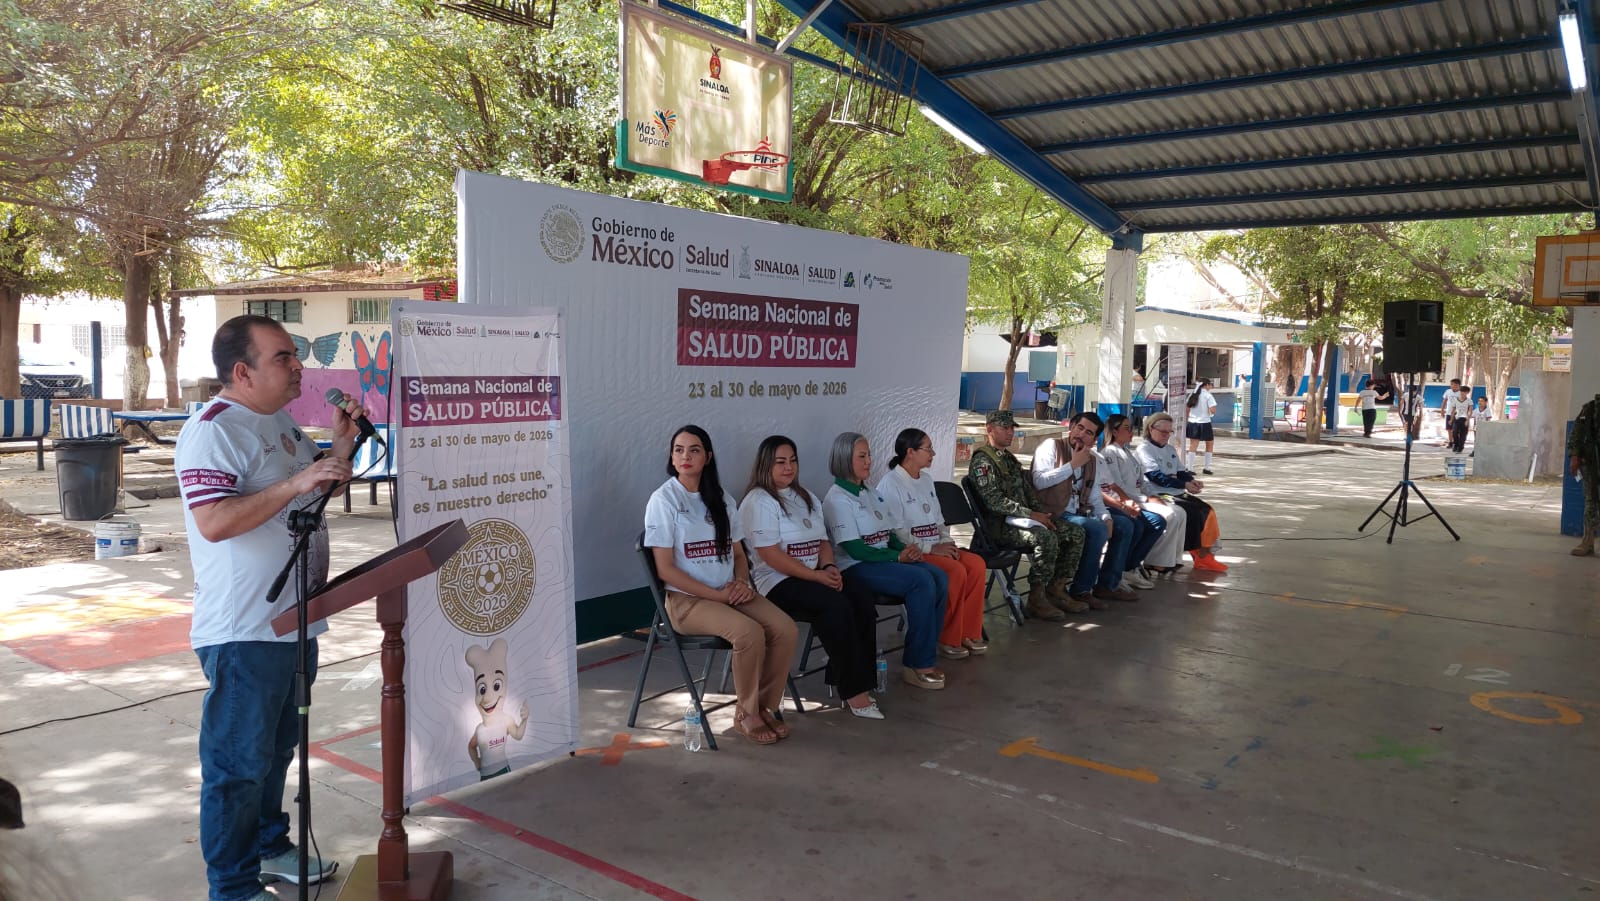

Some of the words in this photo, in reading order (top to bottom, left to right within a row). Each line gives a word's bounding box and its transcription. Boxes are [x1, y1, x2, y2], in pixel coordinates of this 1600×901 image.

[700, 78, 730, 95] SINALOA
[636, 121, 656, 136] Más
[639, 133, 670, 149] Deporte
[592, 216, 657, 241] Gobierno
[660, 227, 675, 243] de
[591, 233, 675, 270] México
[686, 244, 729, 269] Salud
[754, 259, 800, 276] SINALOA
[808, 266, 836, 280] SALUD
[688, 295, 759, 322] Semana
[765, 301, 831, 327] Nacional
[834, 307, 852, 327] de
[417, 326, 452, 337] México
[456, 326, 476, 335] Salud
[688, 331, 763, 359] SALUD
[769, 329, 850, 361] PÚBLICA
[408, 380, 470, 395] Semana
[475, 379, 533, 394] Nacional
[537, 378, 553, 393] de
[688, 383, 706, 398] 23
[711, 381, 723, 396] al
[728, 382, 744, 396] 30
[749, 381, 765, 395] de
[768, 383, 802, 399] mayo
[805, 381, 818, 395] de
[823, 381, 847, 395] 2026
[408, 402, 474, 422] SALUD
[480, 397, 553, 419] PÚBLICA
[409, 437, 425, 449] 23
[431, 435, 442, 448] al
[446, 435, 459, 446] 30
[463, 433, 477, 445] de
[481, 433, 511, 447] mayo
[514, 431, 526, 442] de
[529, 430, 553, 441] 2026
[451, 472, 488, 488] salud
[493, 472, 516, 484] nos
[520, 469, 545, 482] une,
[413, 501, 430, 514] es
[436, 494, 492, 512] nuestro
[688, 549, 711, 557] SALUD
[474, 595, 508, 614] 2026
